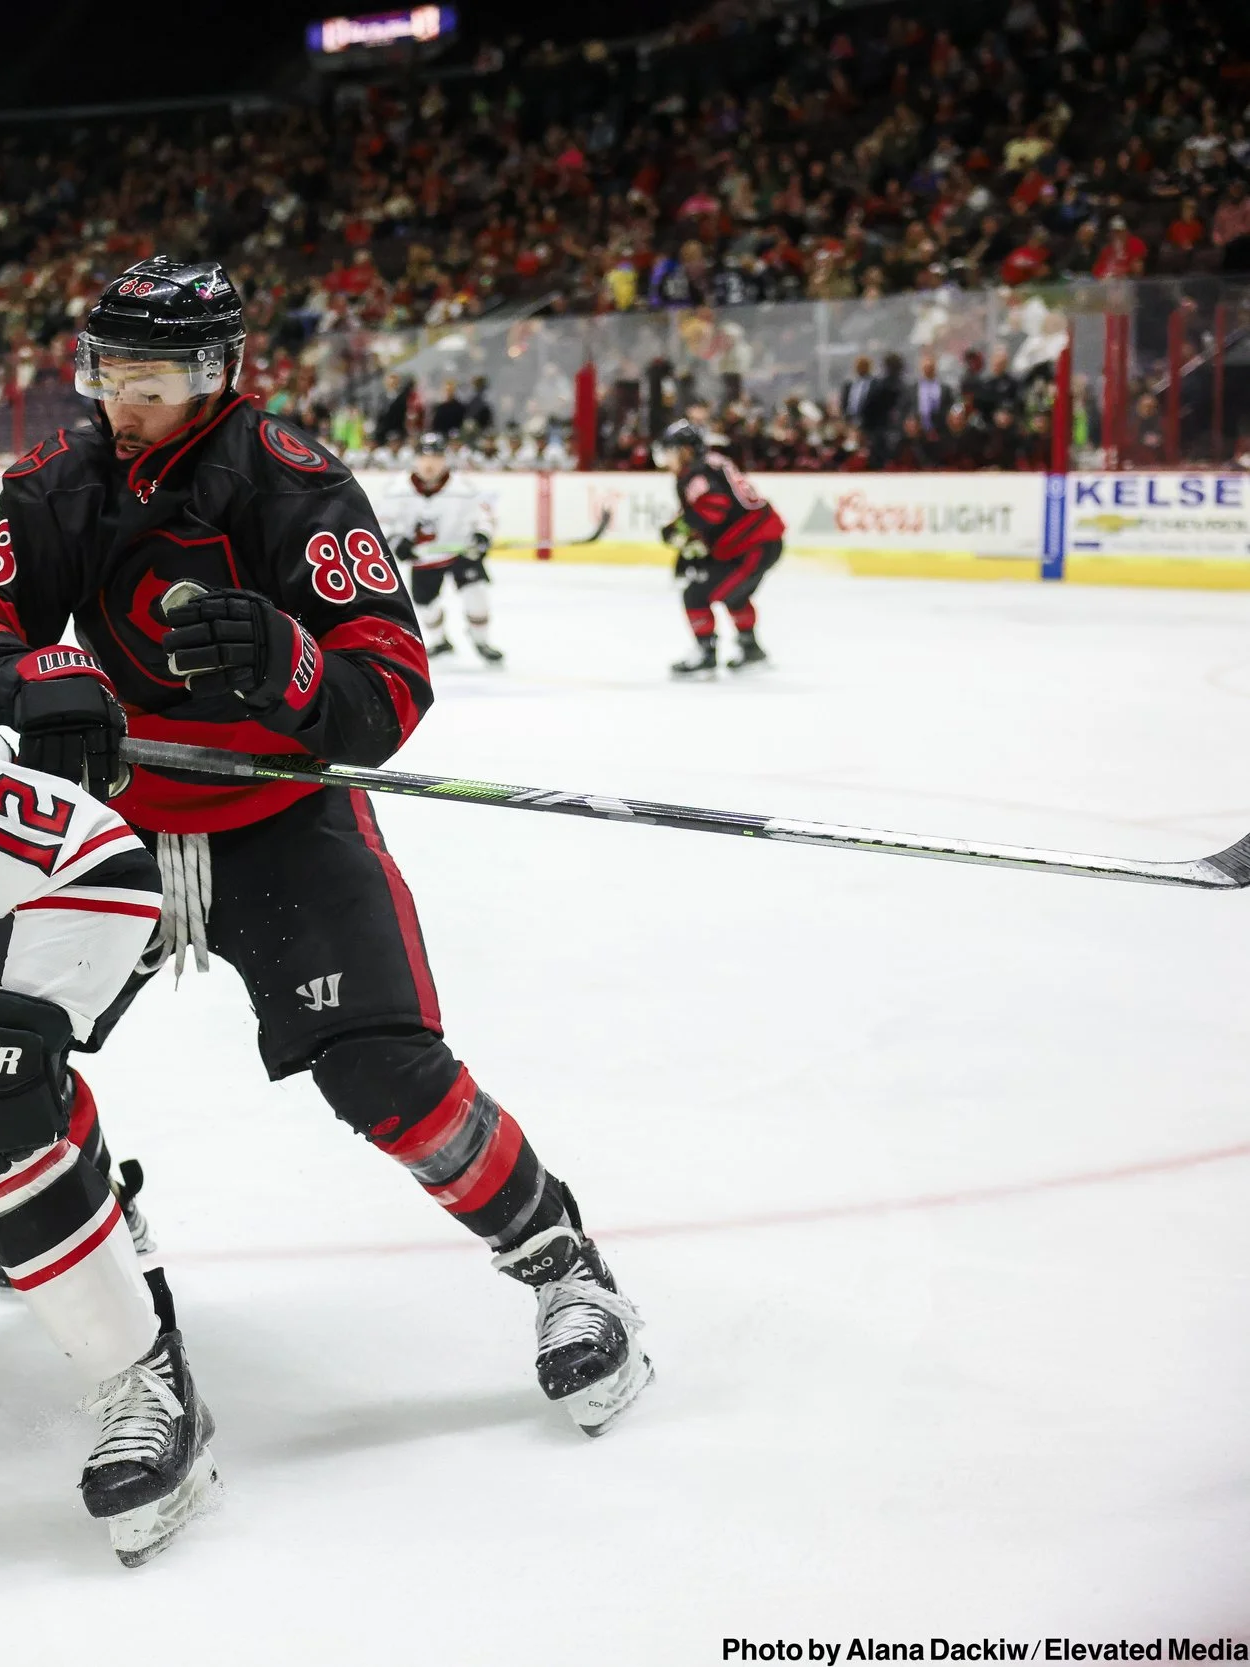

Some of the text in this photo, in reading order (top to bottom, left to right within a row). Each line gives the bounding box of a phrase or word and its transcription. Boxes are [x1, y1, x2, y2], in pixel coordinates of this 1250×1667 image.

[118, 279, 155, 297] 88
[1075, 477, 1243, 508] KELSE
[928, 502, 1014, 535] LIGHT
[305, 528, 399, 604] 88
[521, 1256, 554, 1278] AAO
